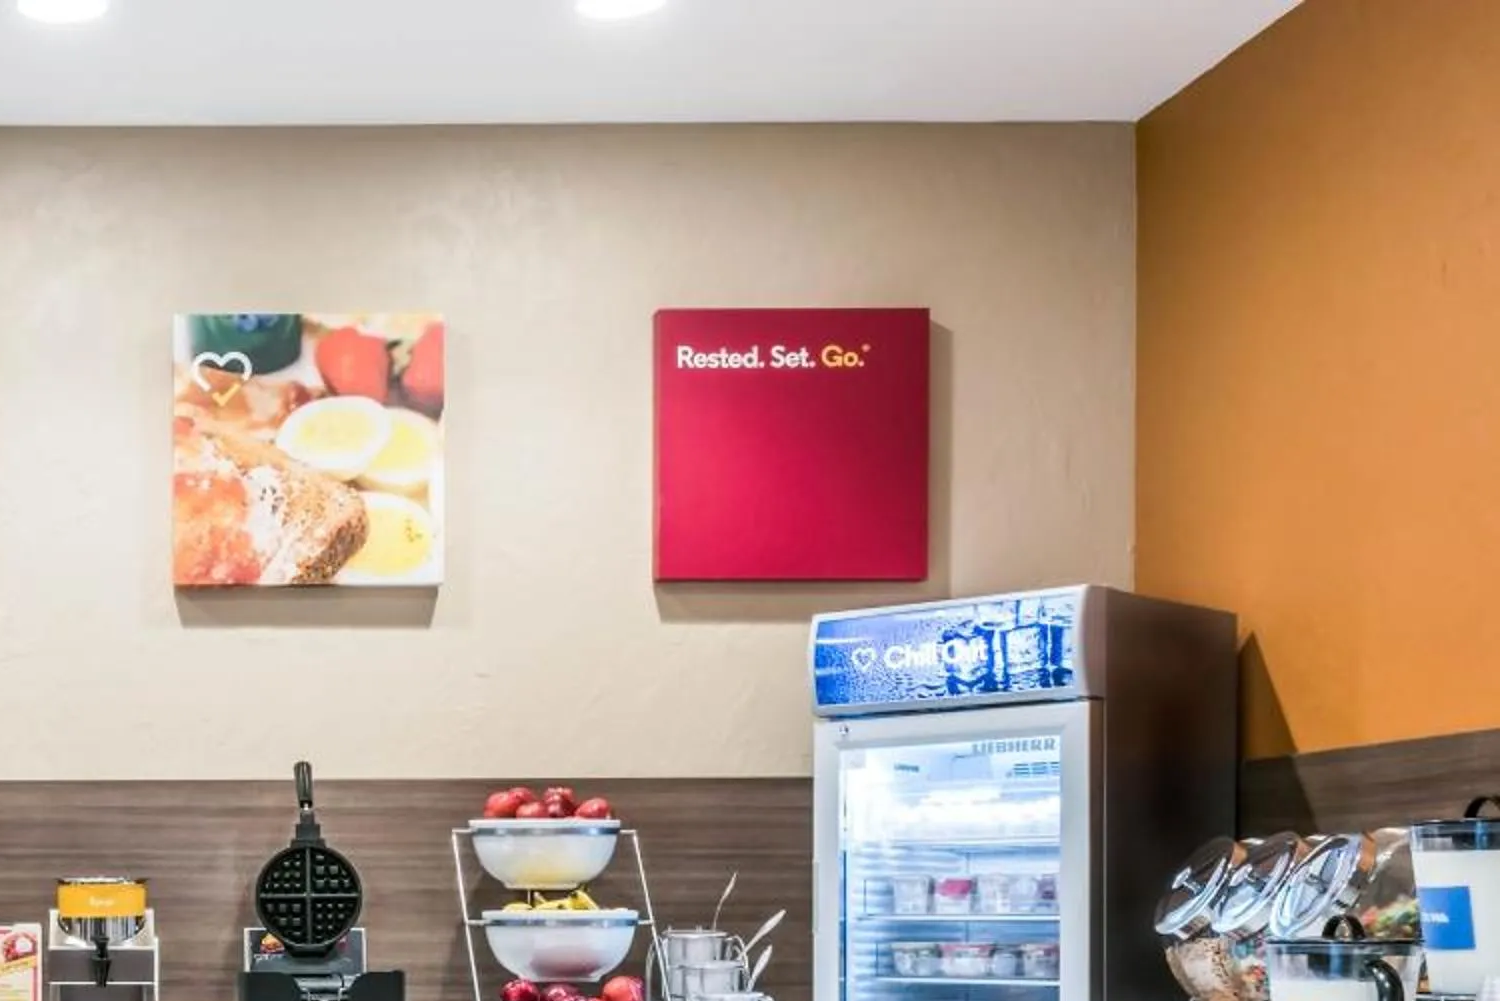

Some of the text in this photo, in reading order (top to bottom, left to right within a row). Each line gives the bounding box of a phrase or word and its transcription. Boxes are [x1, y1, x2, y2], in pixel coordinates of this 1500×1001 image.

[676, 344, 765, 369] Rested.
[769, 344, 816, 369] Set.
[883, 642, 938, 669] Chill
[970, 738, 1056, 757] LIEBHERR
